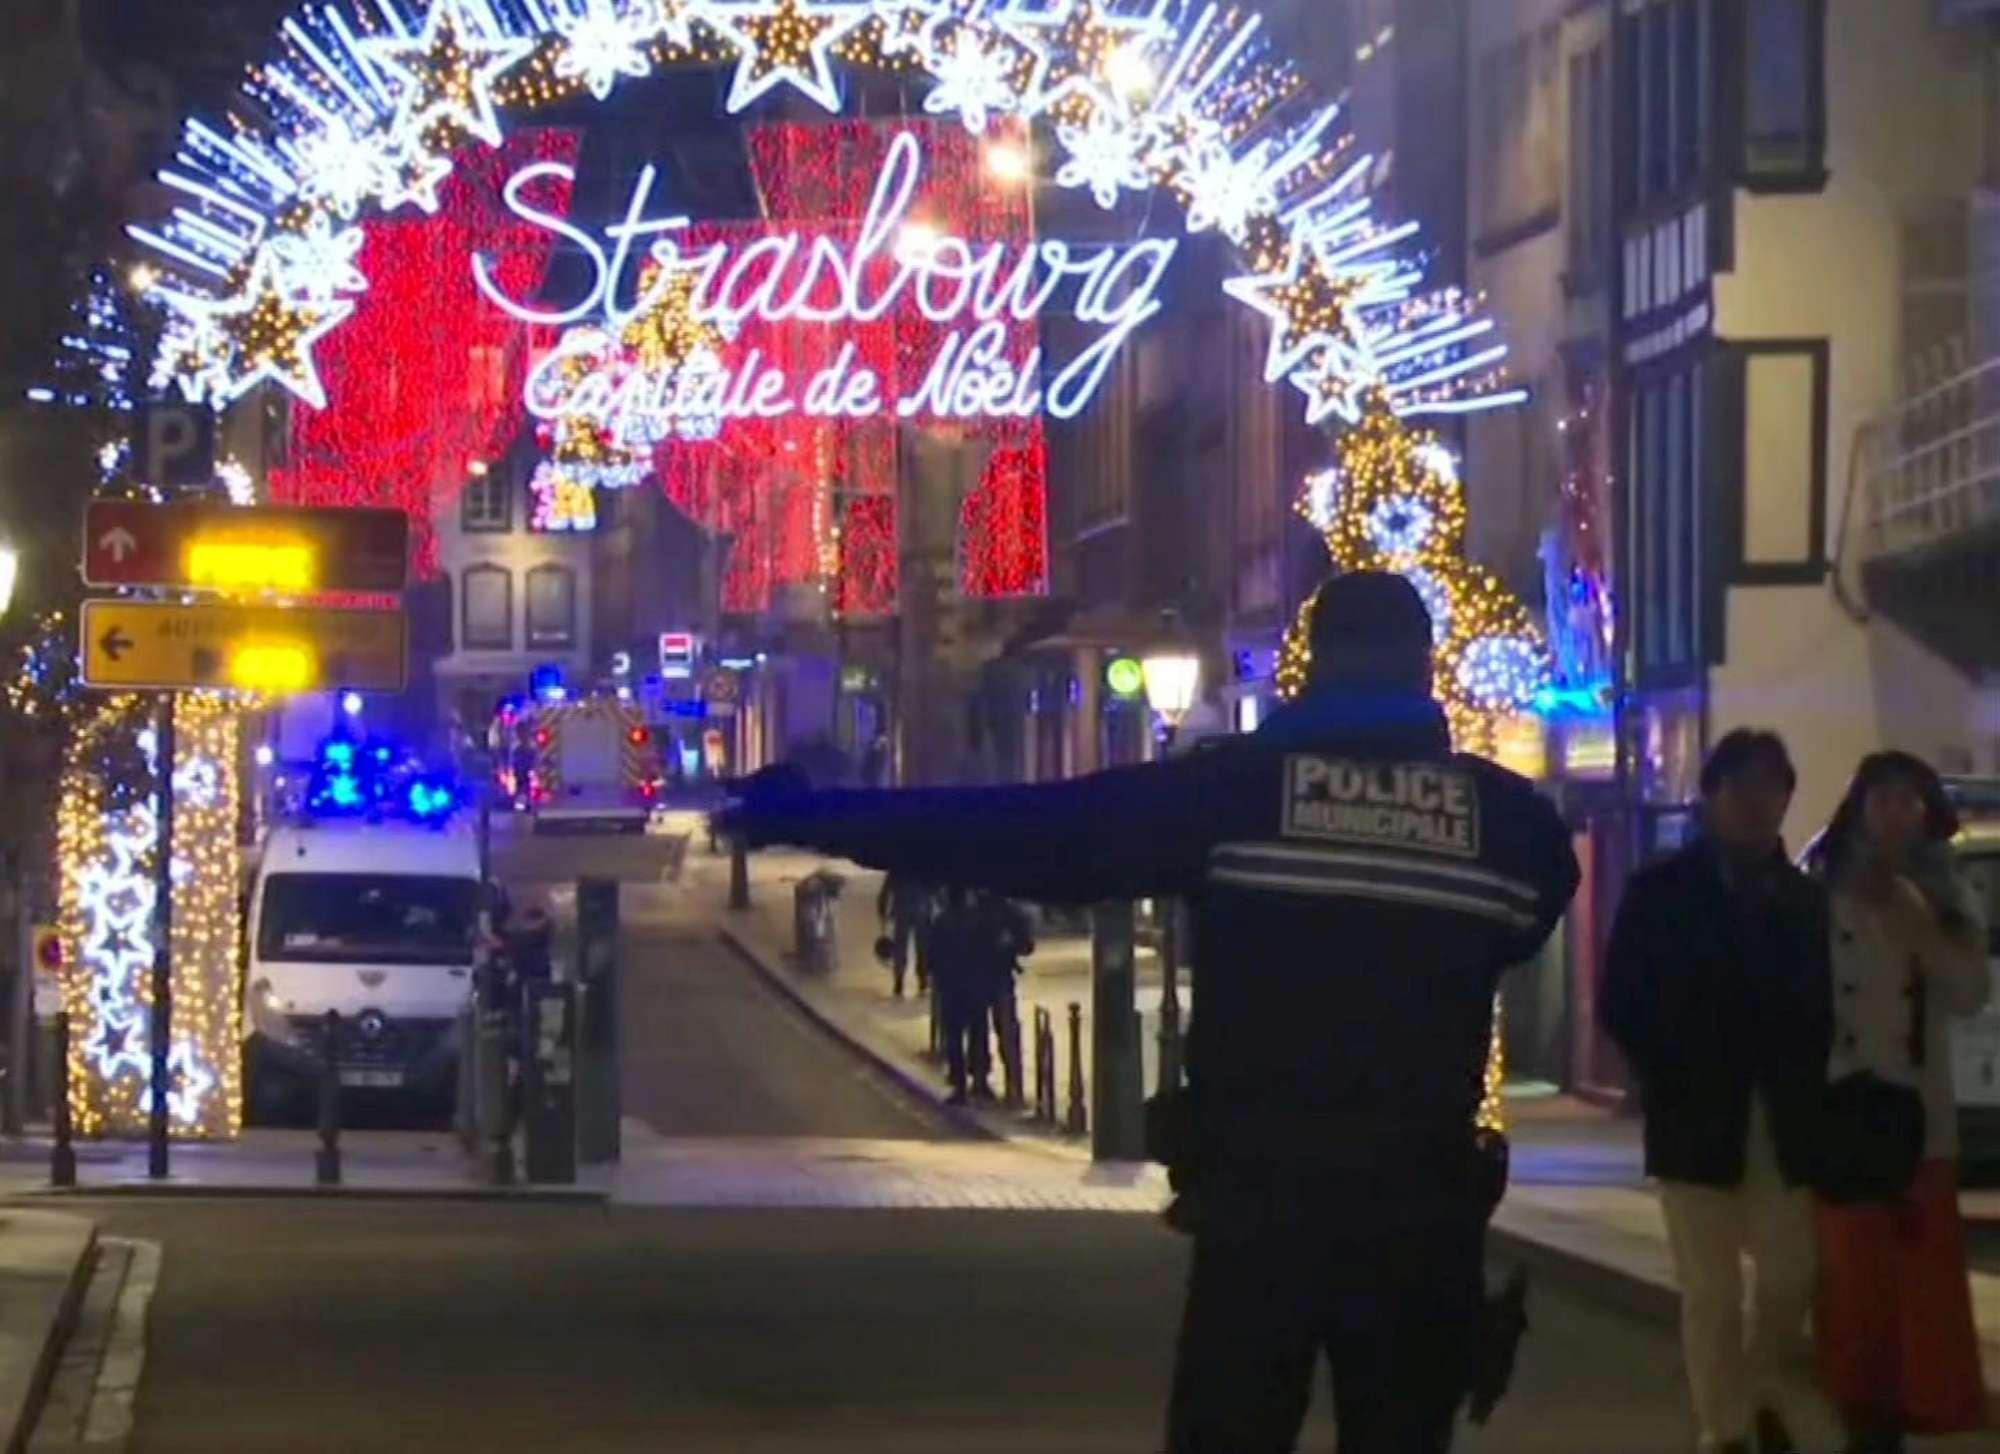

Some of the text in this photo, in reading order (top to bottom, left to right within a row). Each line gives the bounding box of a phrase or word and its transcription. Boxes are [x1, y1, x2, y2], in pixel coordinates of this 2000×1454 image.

[471, 131, 1178, 419] Strasbourg
[523, 321, 1043, 434] Capitale de Noël
[149, 409, 196, 481] P
[1295, 757, 1470, 815] POLICE
[1293, 801, 1470, 847] MUNICIPALE
